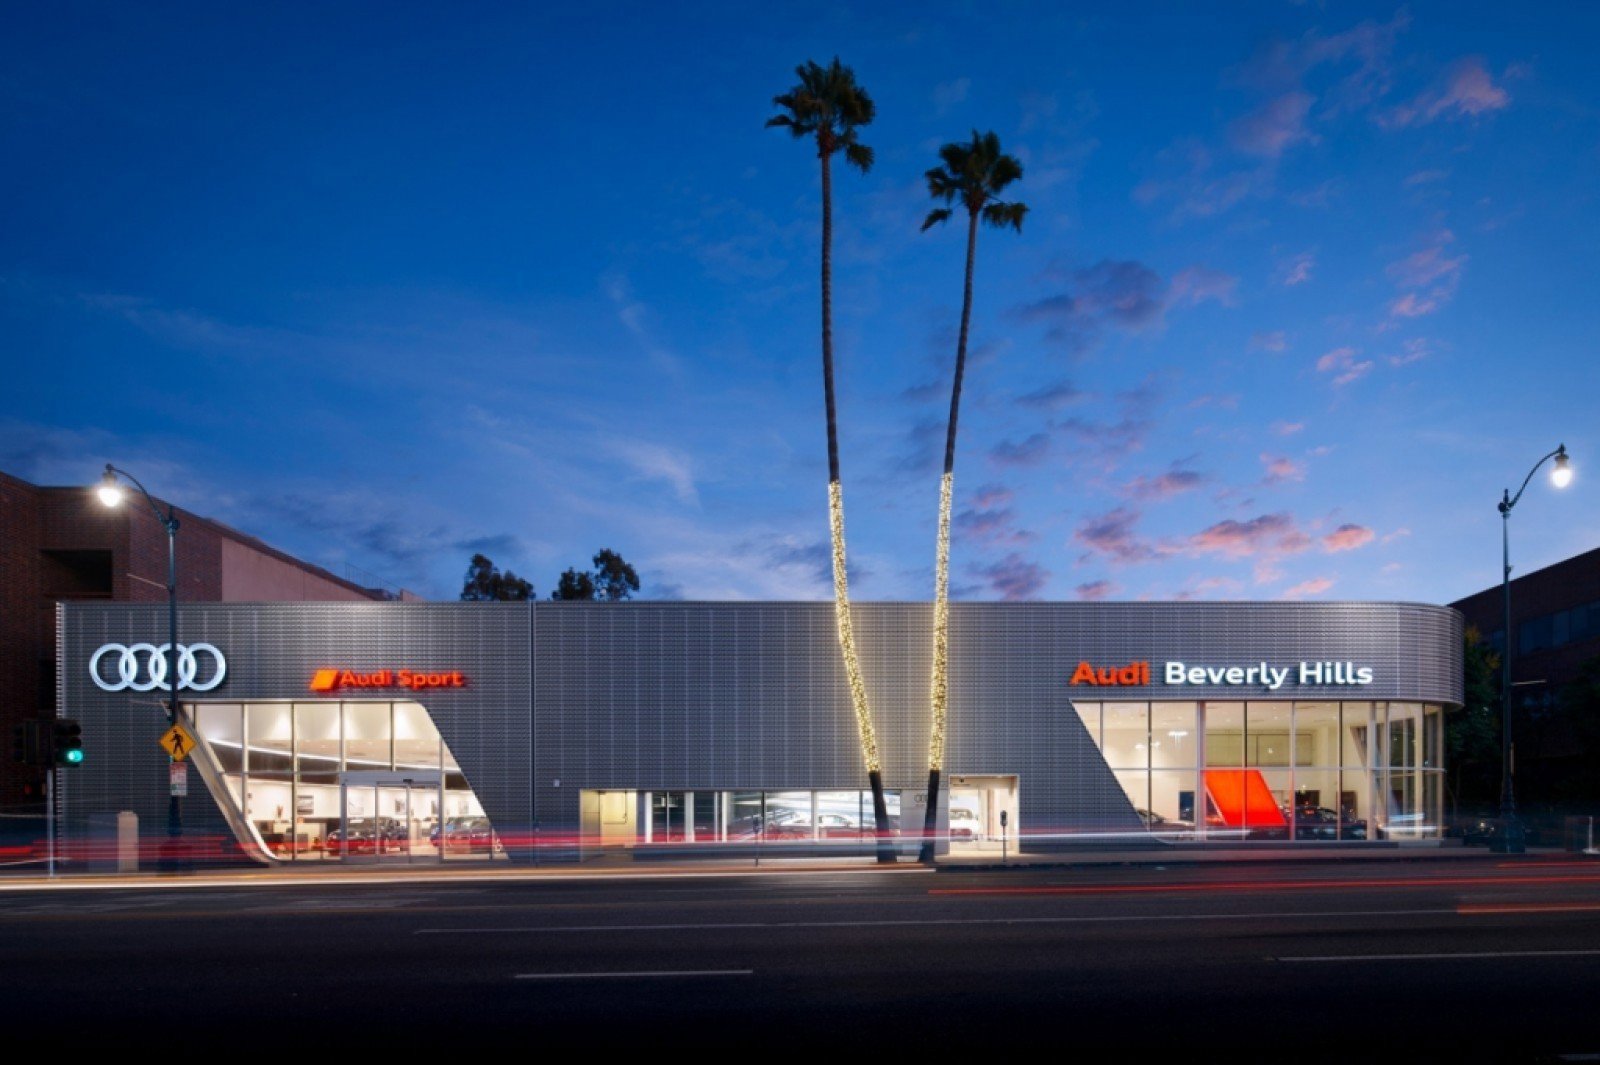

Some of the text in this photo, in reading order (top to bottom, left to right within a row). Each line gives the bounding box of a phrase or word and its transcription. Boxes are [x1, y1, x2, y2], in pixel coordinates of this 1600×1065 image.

[340, 669, 464, 691] Audi Sport
[1070, 661, 1374, 690] Audi Beverly Hills
